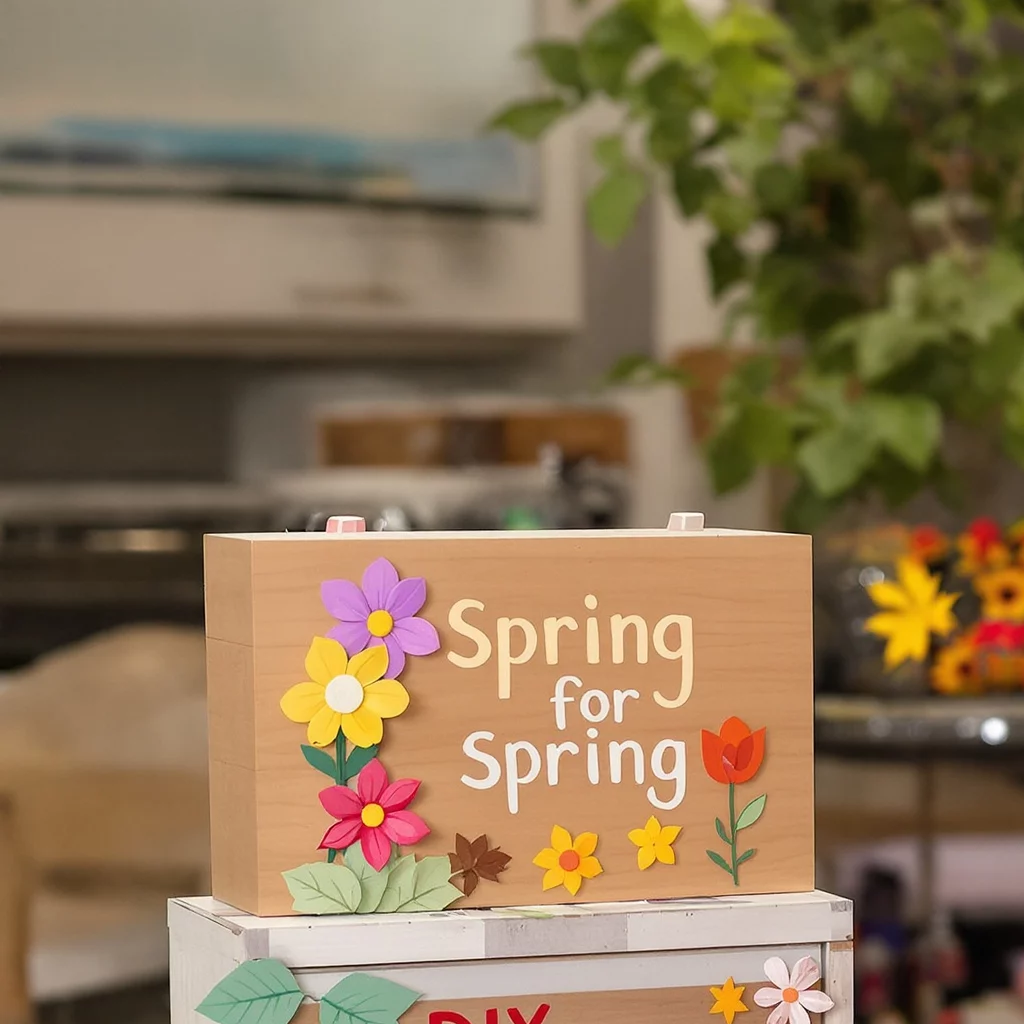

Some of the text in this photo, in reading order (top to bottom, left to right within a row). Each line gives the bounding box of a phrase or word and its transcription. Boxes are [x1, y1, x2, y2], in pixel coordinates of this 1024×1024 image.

[447, 594, 694, 708] Spring
[550, 675, 639, 730] for
[460, 727, 686, 814] Spring
